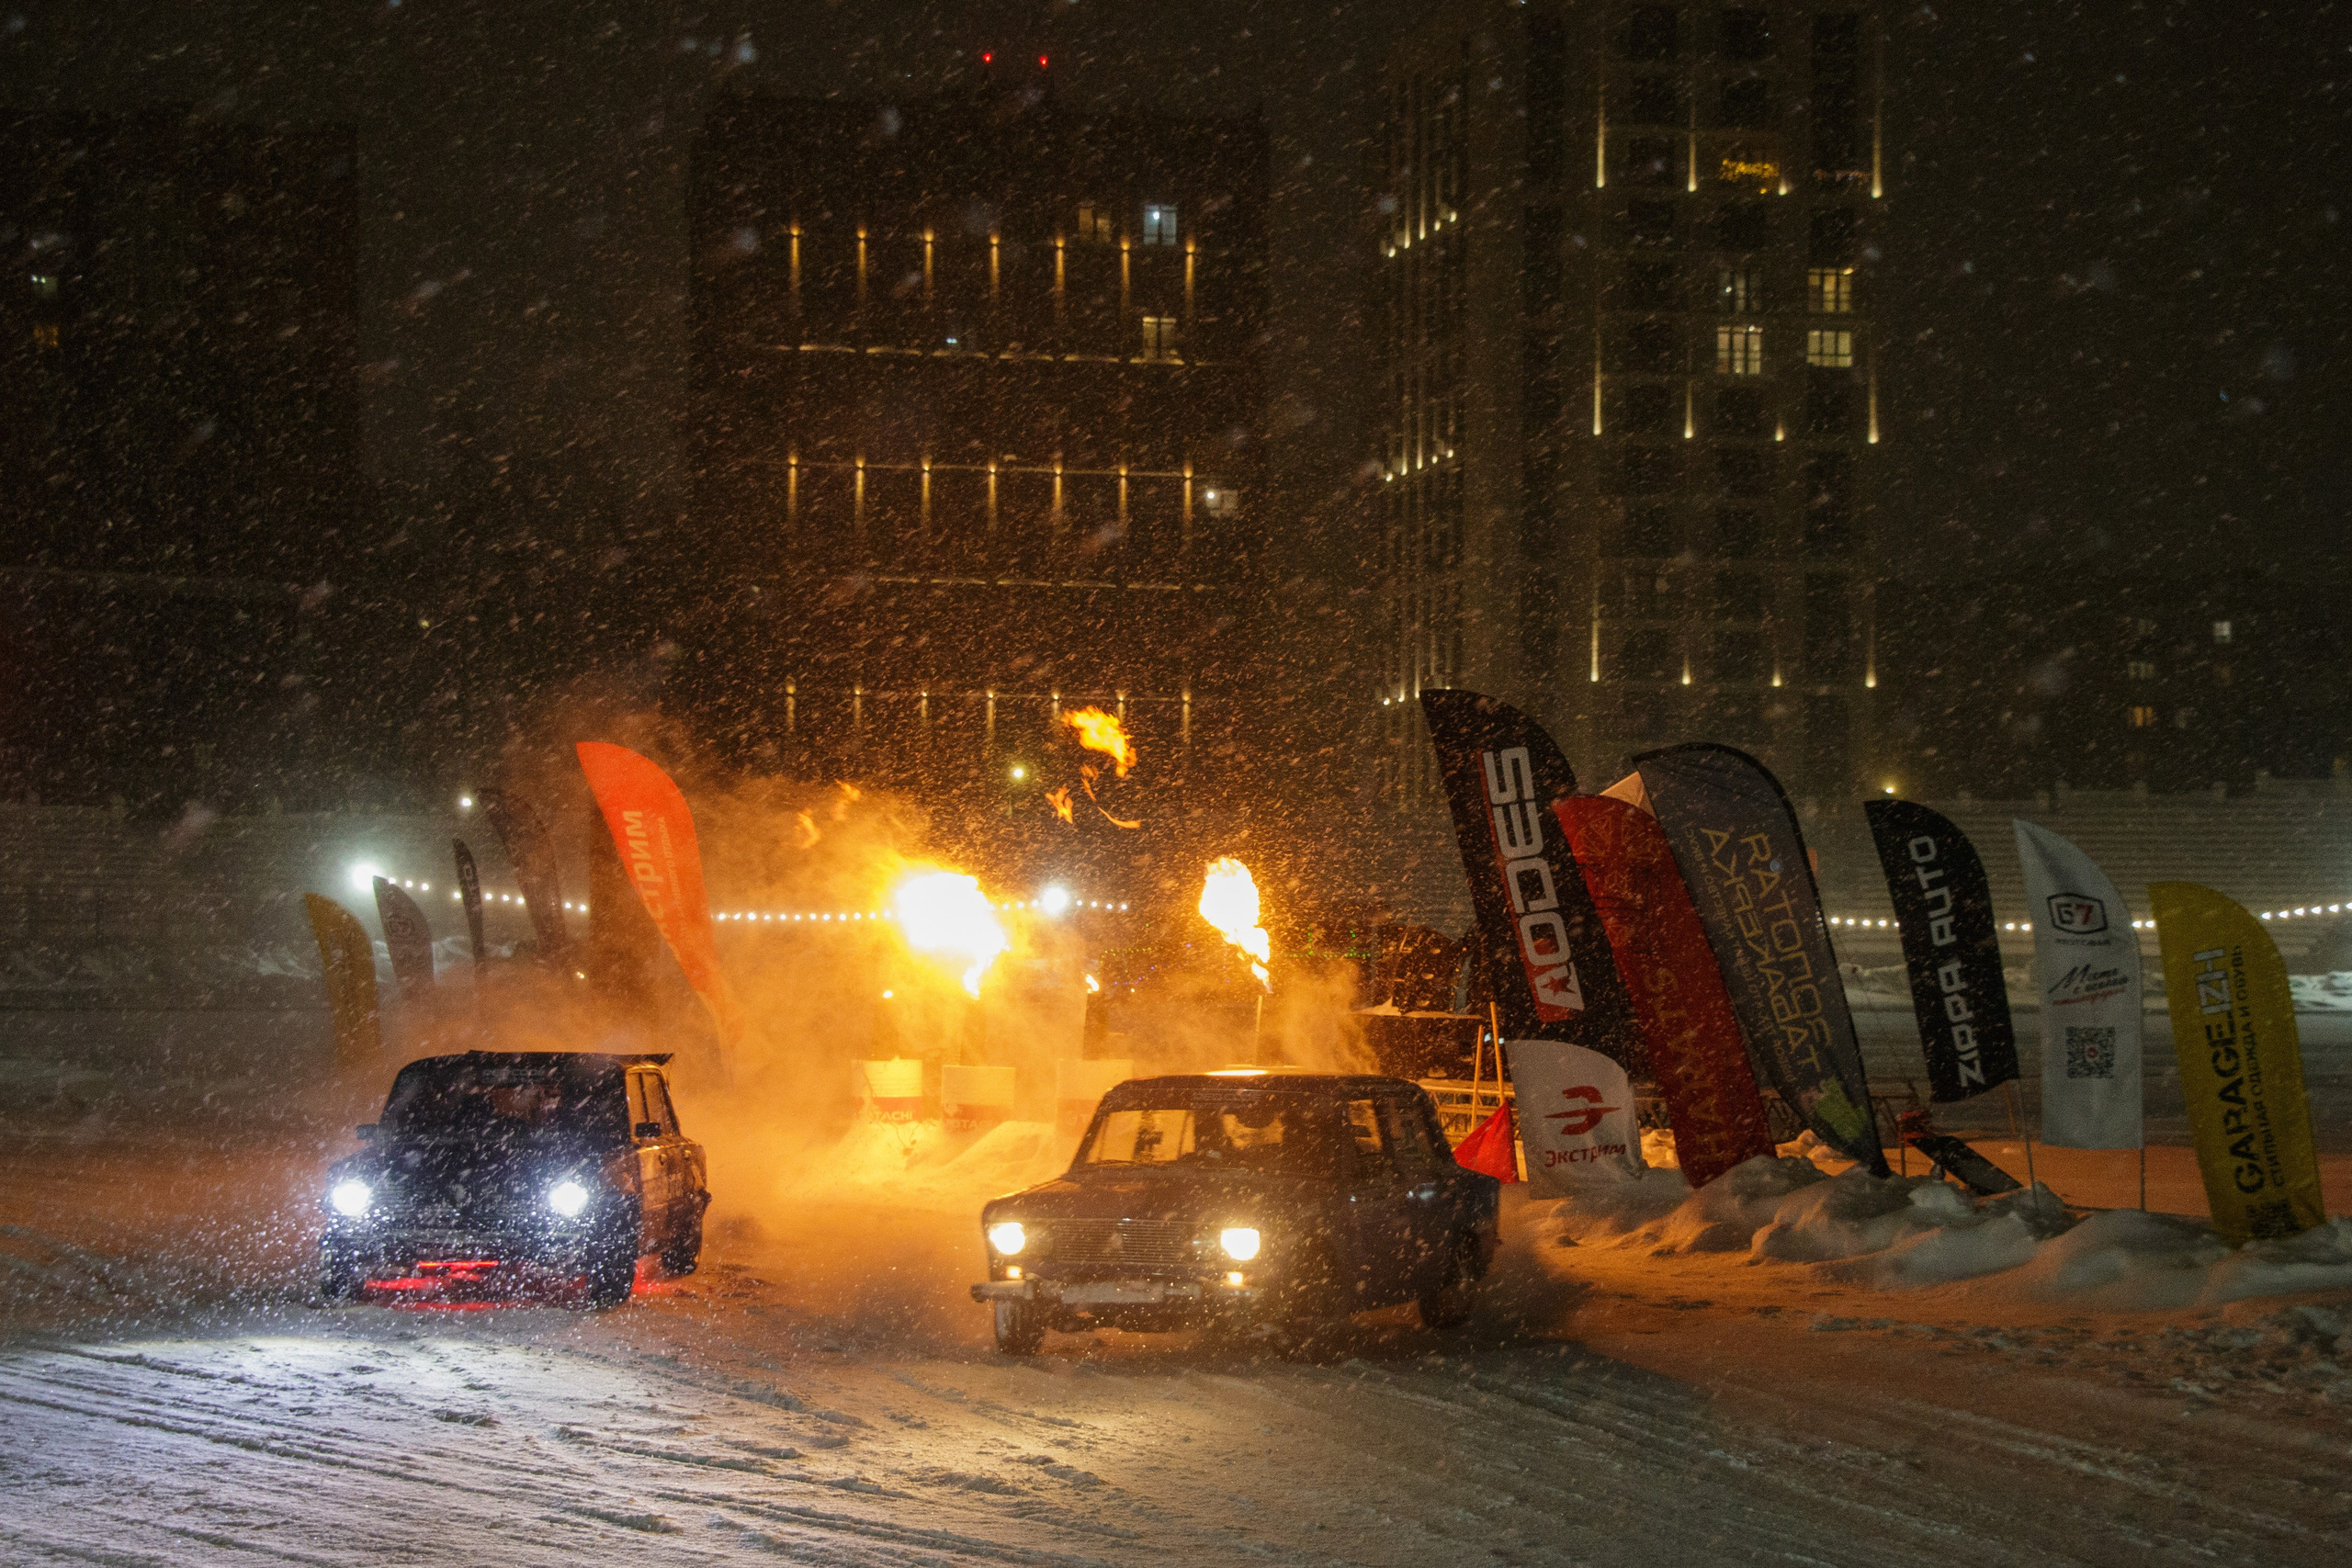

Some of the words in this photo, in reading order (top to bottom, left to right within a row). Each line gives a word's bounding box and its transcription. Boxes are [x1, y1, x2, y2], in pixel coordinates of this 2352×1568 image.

[1908, 835, 1958, 946] AUTO
[1938, 960, 1986, 1089] ZIPPA
[2242, 1021, 2263, 1096] ОДЕЖДА
[2256, 1100, 2284, 1186] СТИЛЬНАЯ
